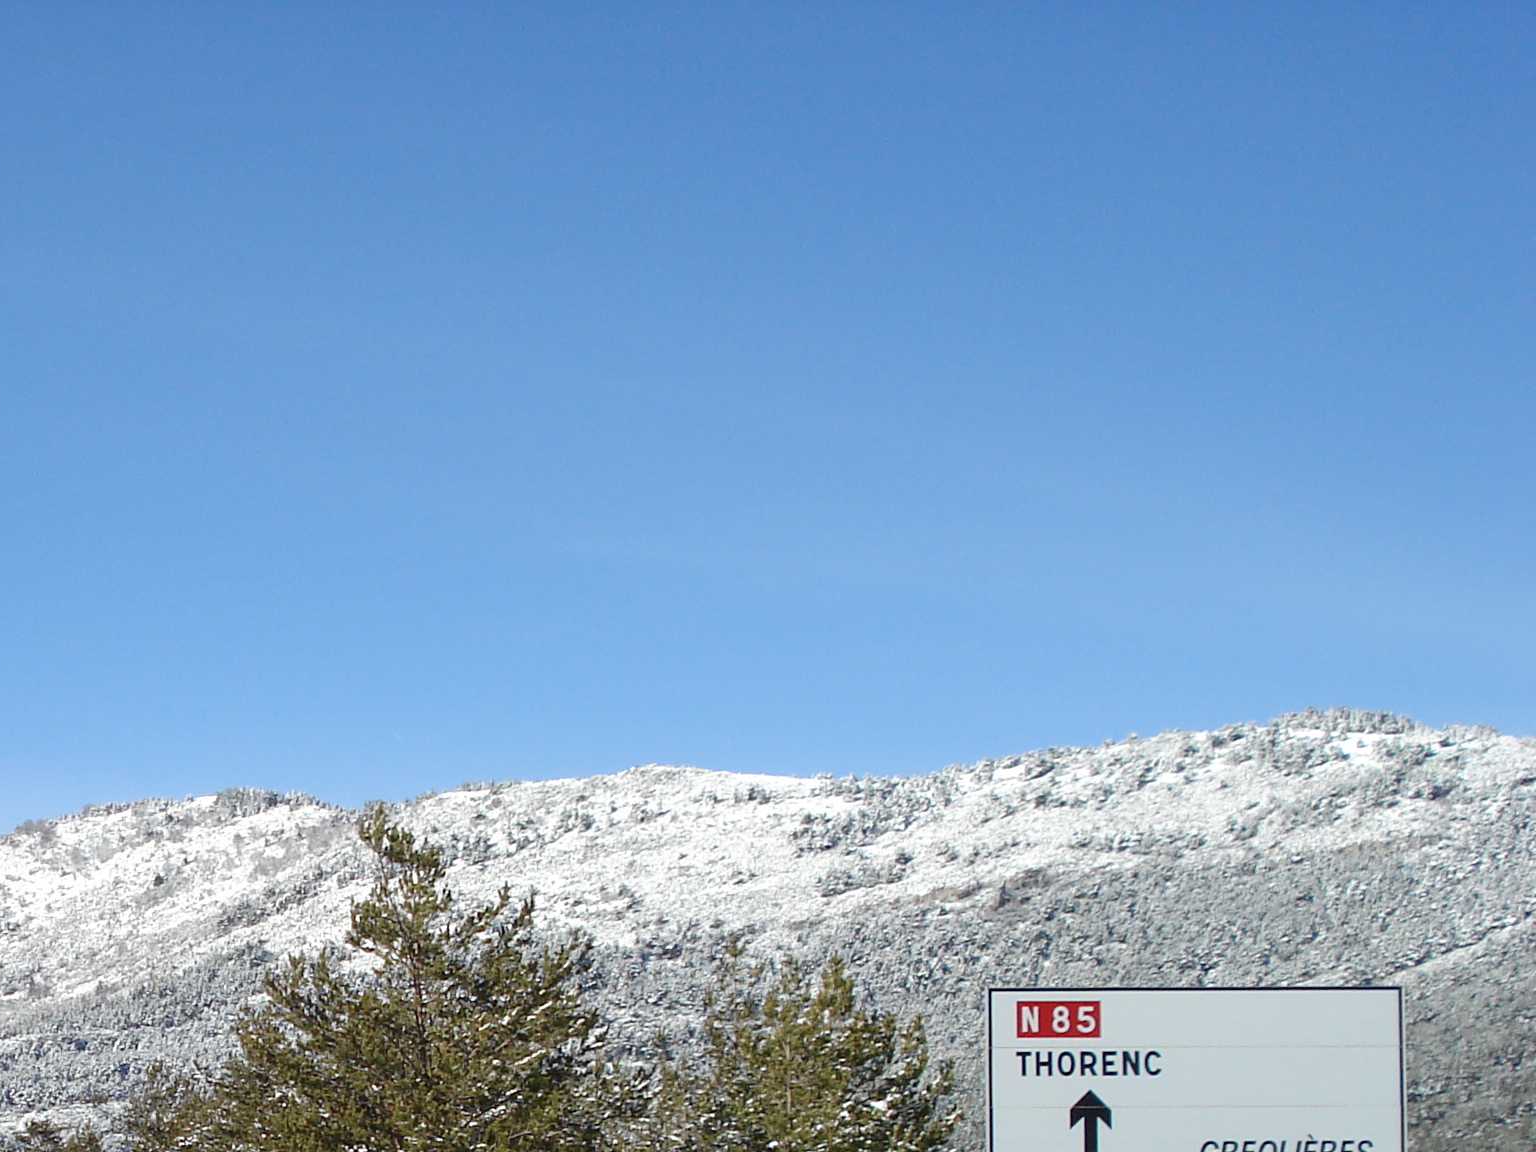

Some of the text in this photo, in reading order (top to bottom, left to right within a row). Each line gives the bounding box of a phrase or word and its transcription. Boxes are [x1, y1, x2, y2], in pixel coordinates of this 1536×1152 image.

[1020, 1005, 1097, 1034] N 85
[1016, 1050, 1162, 1077] THORENC
